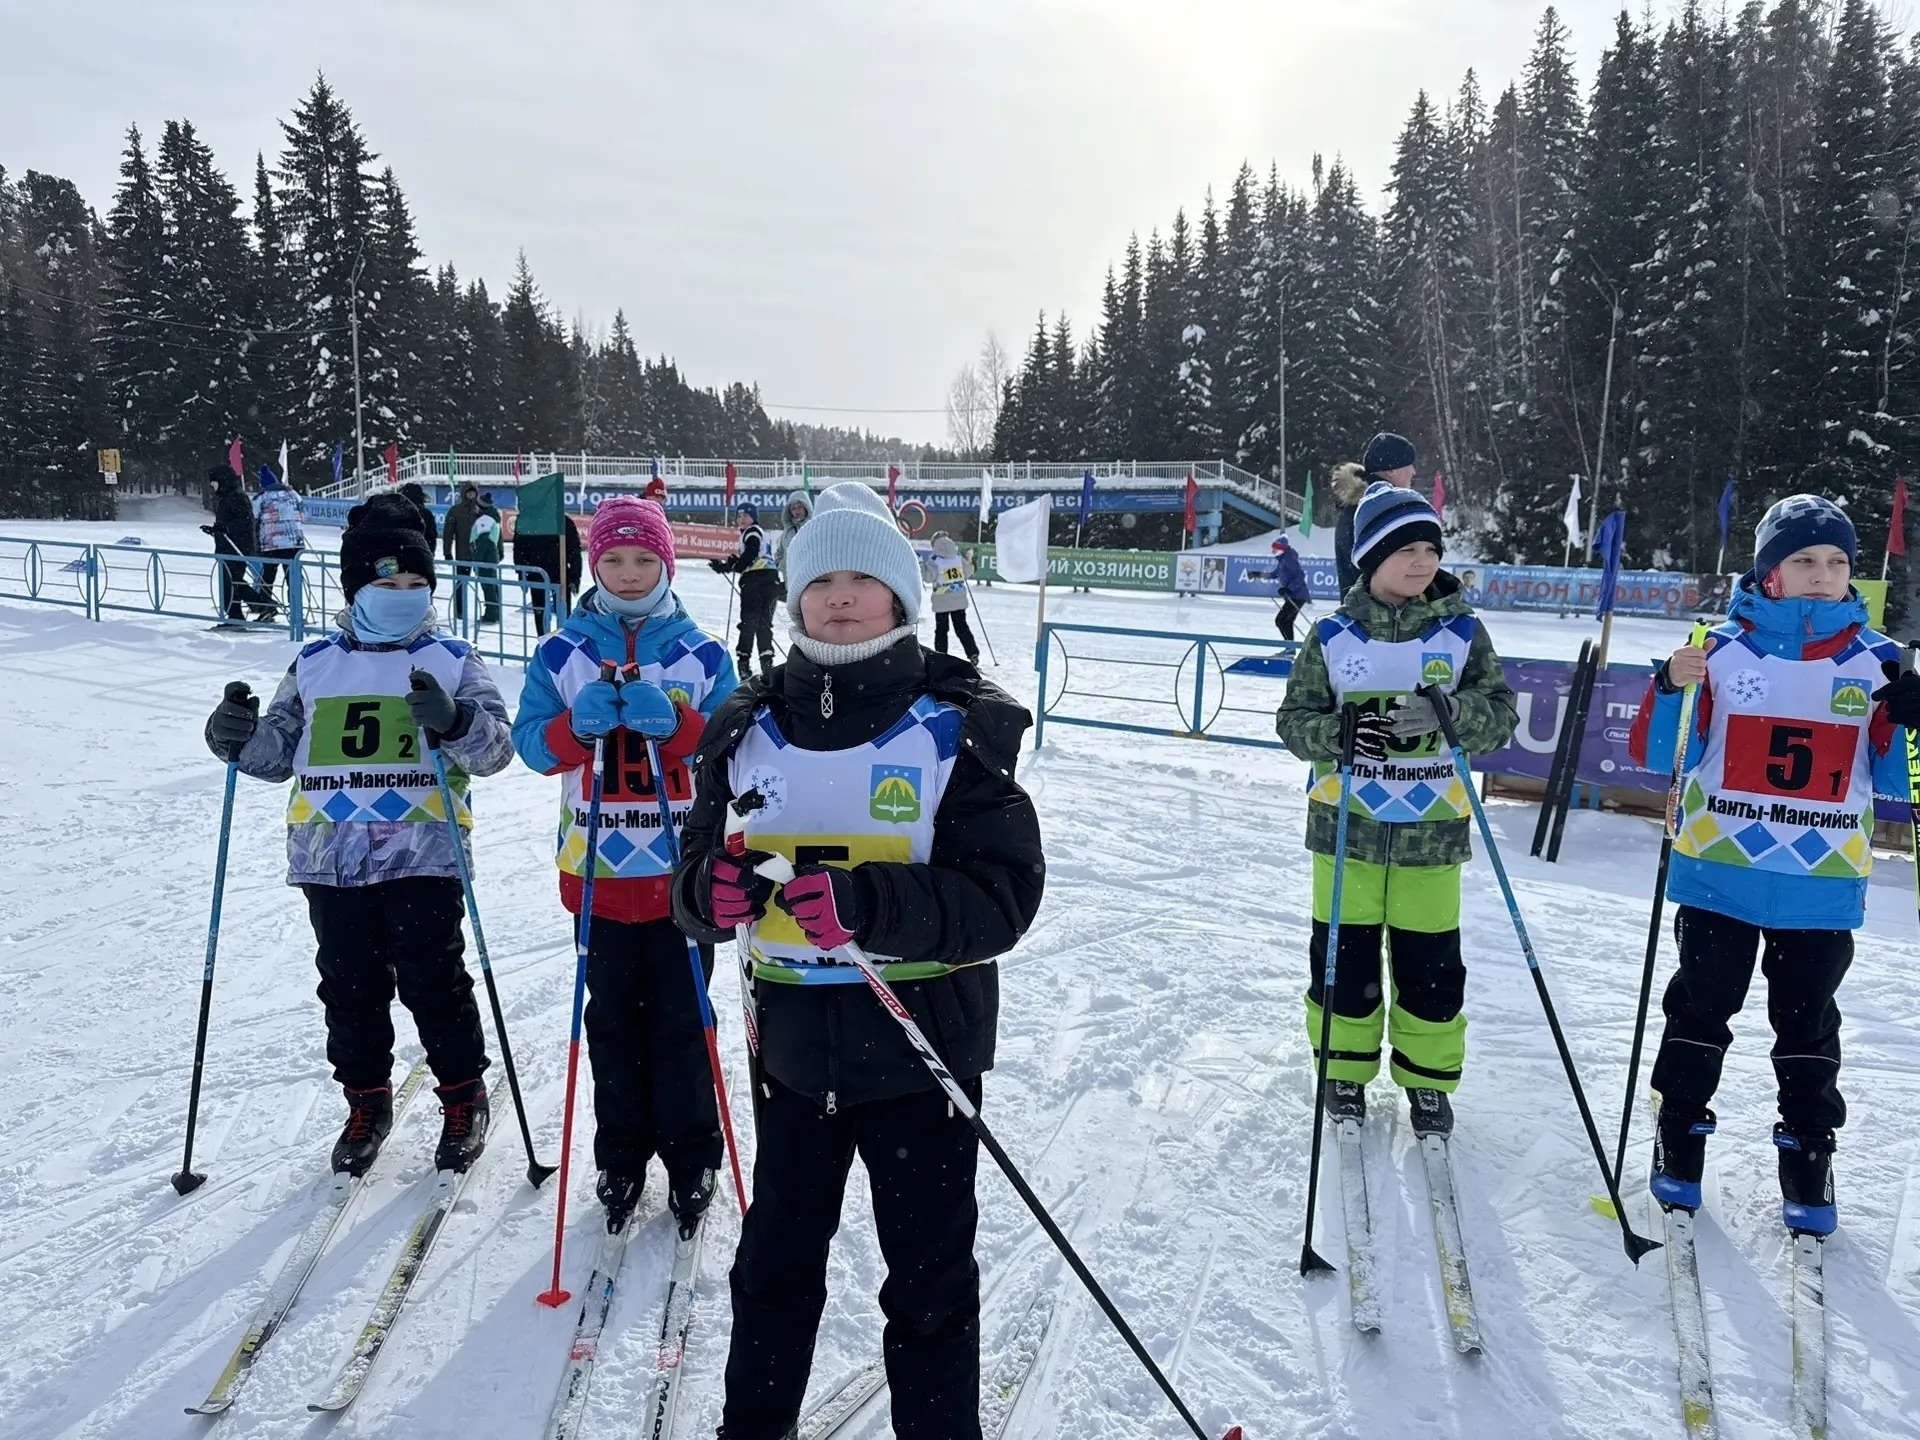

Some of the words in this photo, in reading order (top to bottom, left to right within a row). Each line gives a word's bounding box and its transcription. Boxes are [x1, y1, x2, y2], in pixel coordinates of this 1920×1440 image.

[1072, 560, 1169, 580] ХОЗЯИНОВ
[1487, 579, 1570, 599] АНТОН
[1606, 702, 1641, 720] ПР
[341, 702, 380, 758] 5
[398, 734, 414, 758] 2
[1425, 730, 1438, 752] 2
[1766, 725, 1813, 790] 5
[1829, 770, 1843, 796] 1
[667, 768, 682, 794] 1
